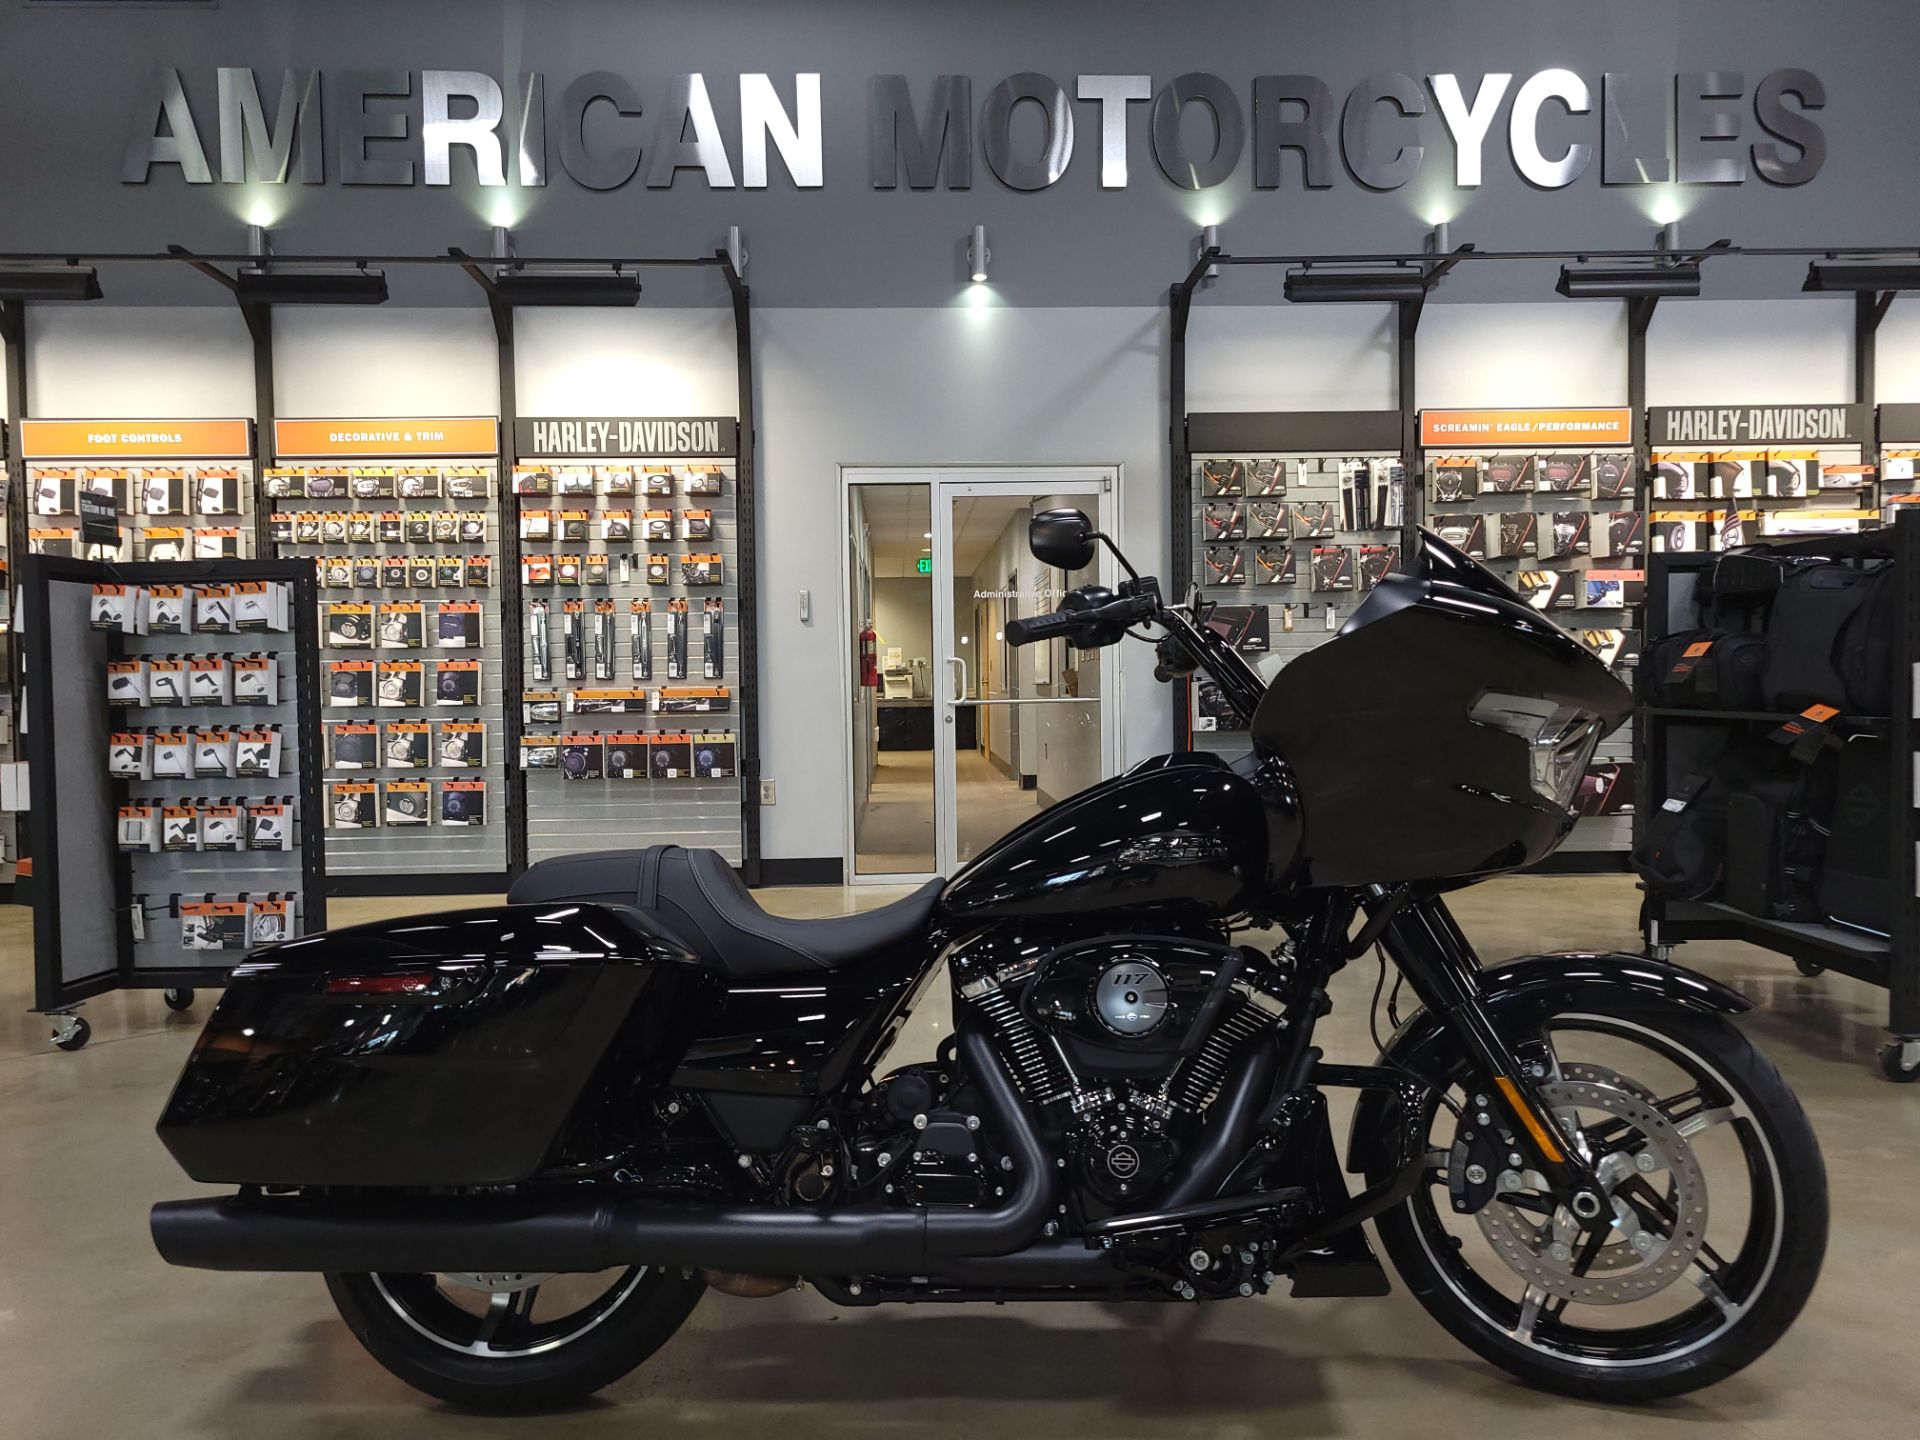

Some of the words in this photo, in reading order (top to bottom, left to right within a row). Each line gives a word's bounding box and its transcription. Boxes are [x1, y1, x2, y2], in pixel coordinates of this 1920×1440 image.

[120, 67, 824, 190] AMERICAN
[873, 68, 1827, 190] MOTORCYCLES
[1433, 423, 1493, 433] SCREAMIN'
[1667, 408, 1847, 441] HARLEY-DAVIDSON
[87, 433, 117, 443] FOOT
[121, 433, 182, 443] CONTROLS
[329, 432, 400, 442] DECORATIVE
[403, 432, 412, 441] &
[416, 431, 444, 441] TRIM
[533, 421, 719, 453] HARLEY-DAVIDSON
[1044, 589, 1068, 598] Offic
[1112, 973, 1150, 985] 117
